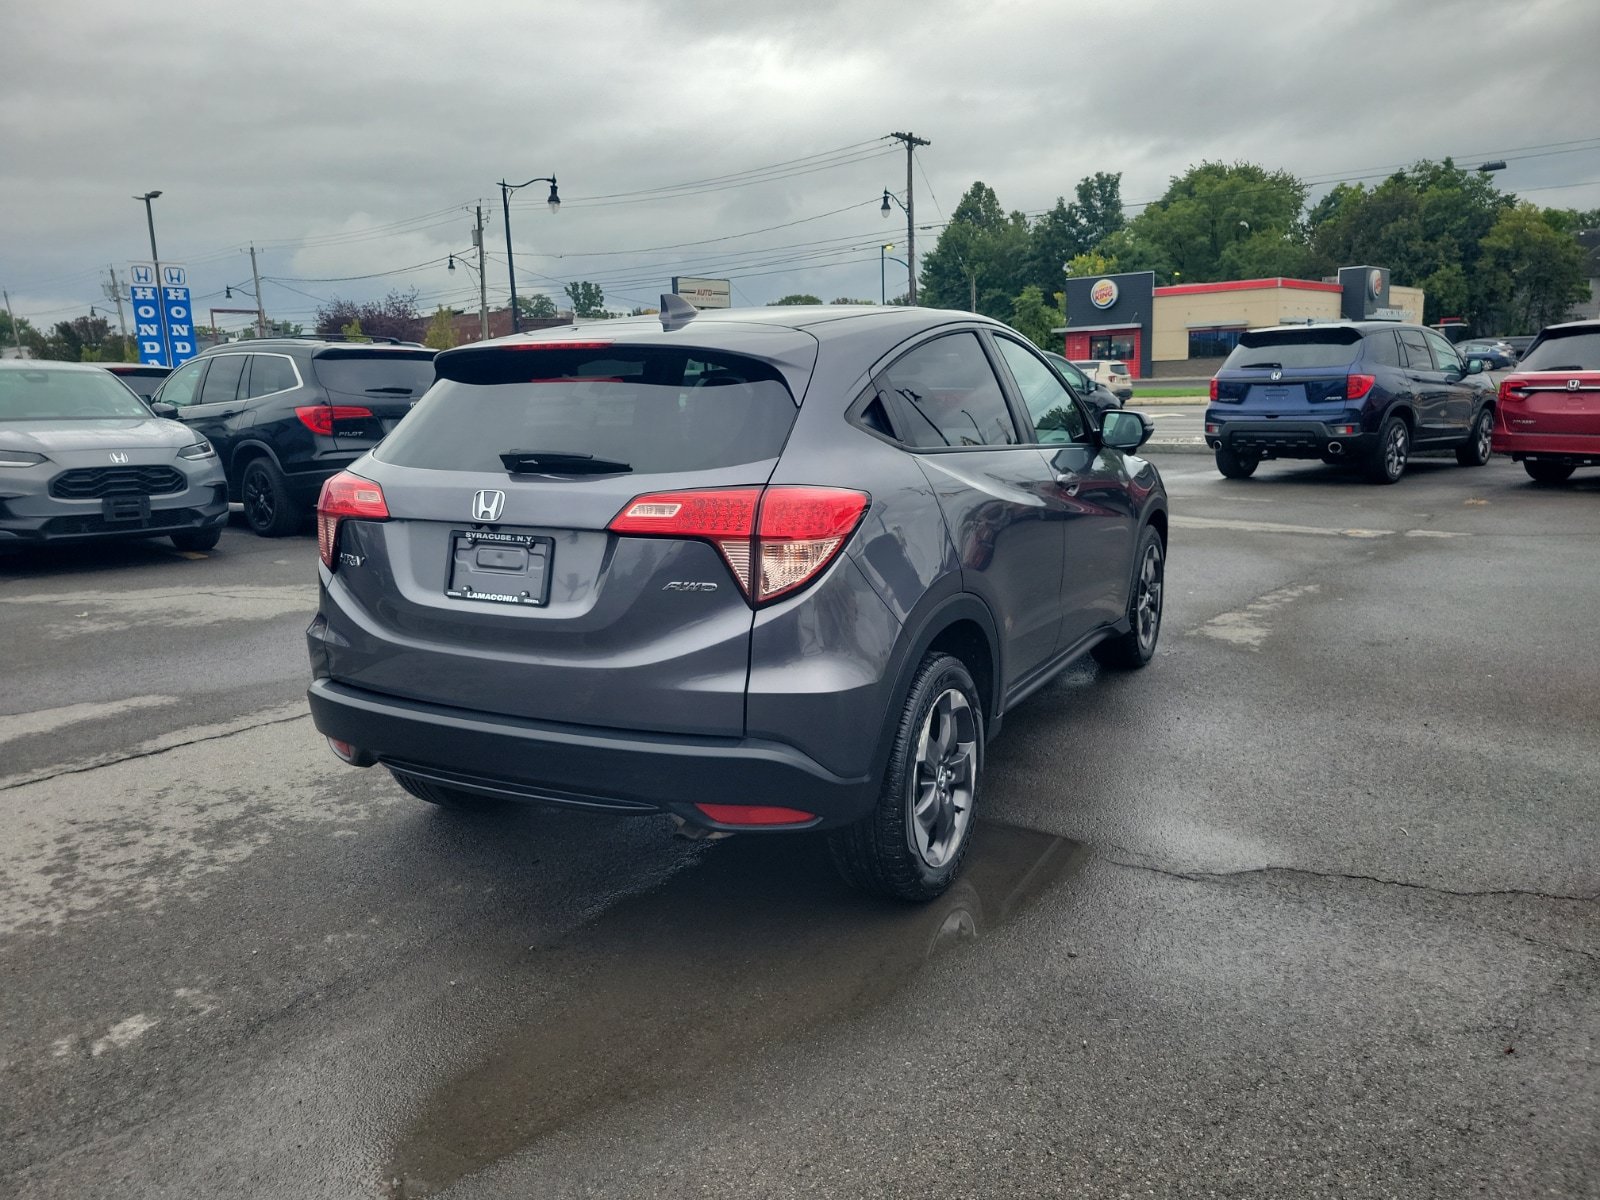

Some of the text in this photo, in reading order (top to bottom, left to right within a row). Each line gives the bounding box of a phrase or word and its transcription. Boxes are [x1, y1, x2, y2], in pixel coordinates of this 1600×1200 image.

[697, 288, 713, 297] AUTO
[1095, 290, 1113, 301] KING
[166, 288, 191, 366] HOND
[662, 581, 718, 591] AWD
[466, 591, 519, 603] LAMACCHIA
